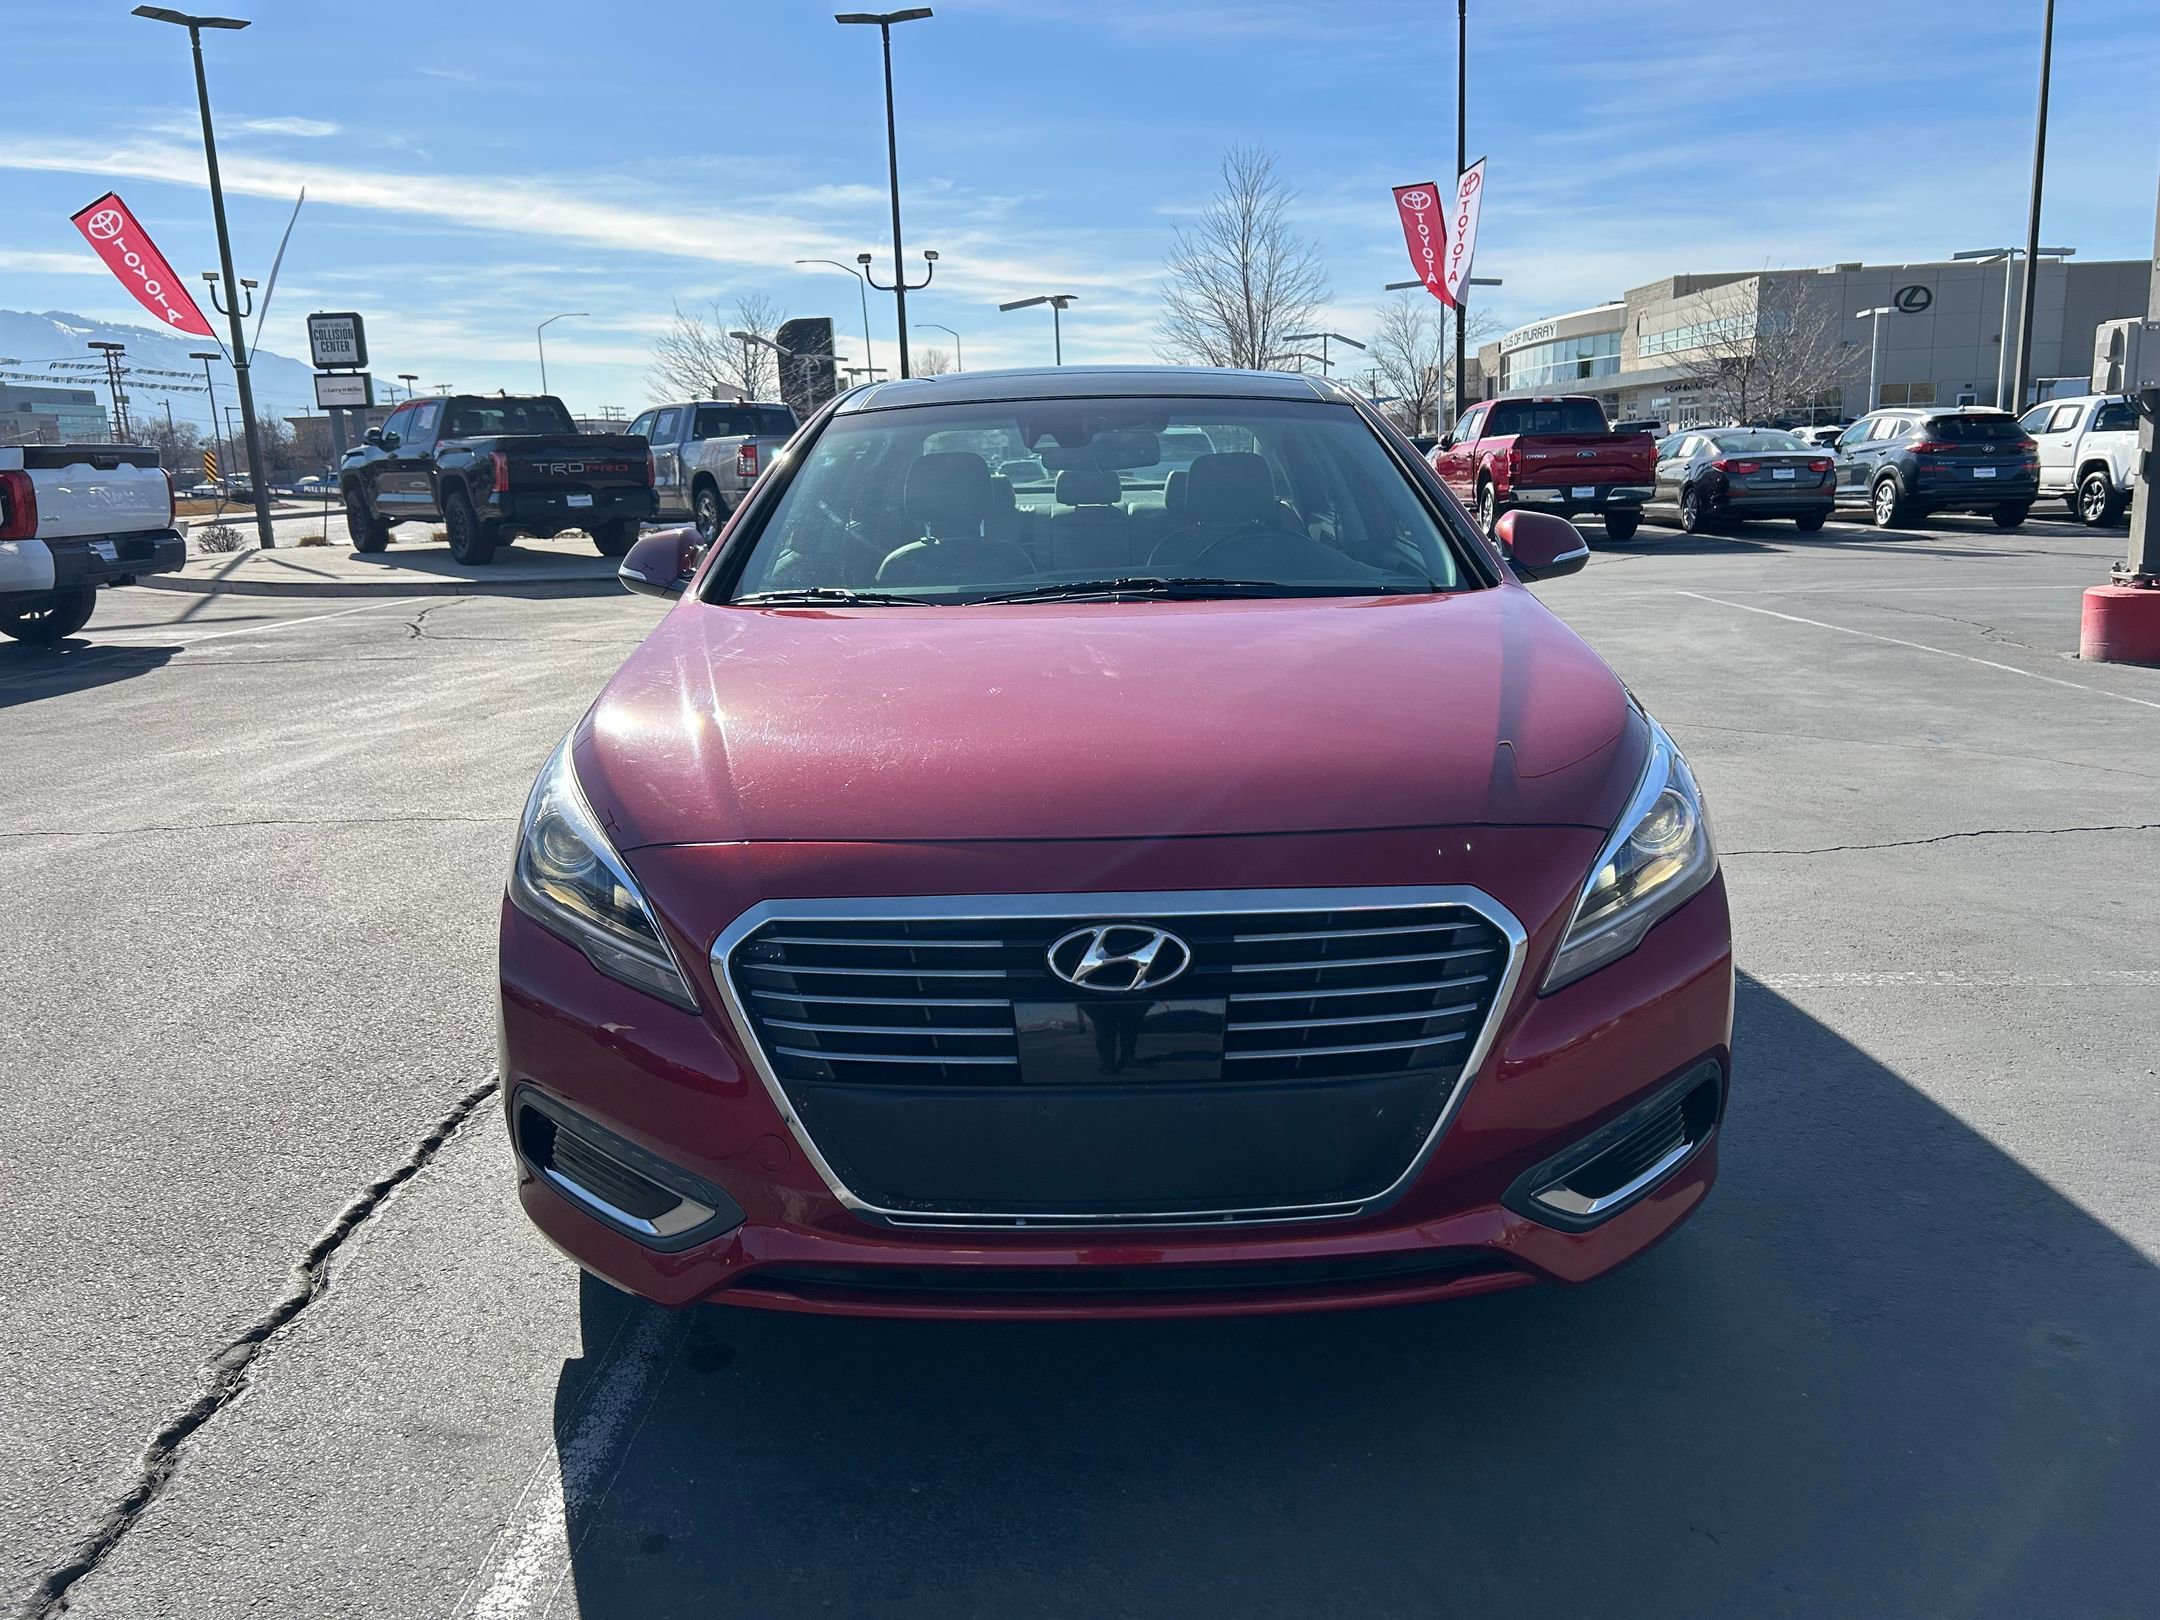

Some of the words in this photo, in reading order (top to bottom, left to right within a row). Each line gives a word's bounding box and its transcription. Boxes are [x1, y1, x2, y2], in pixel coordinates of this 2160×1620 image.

[1415, 212, 1438, 284] TOYOTA
[1448, 200, 1470, 283] TOYOTA
[112, 237, 184, 323] TOYOTA
[313, 328, 354, 341] COLLISION
[1522, 323, 1556, 343] MURRAY
[320, 340, 351, 353] CENTER
[532, 463, 585, 475] TRD
[585, 463, 630, 472] PRO
